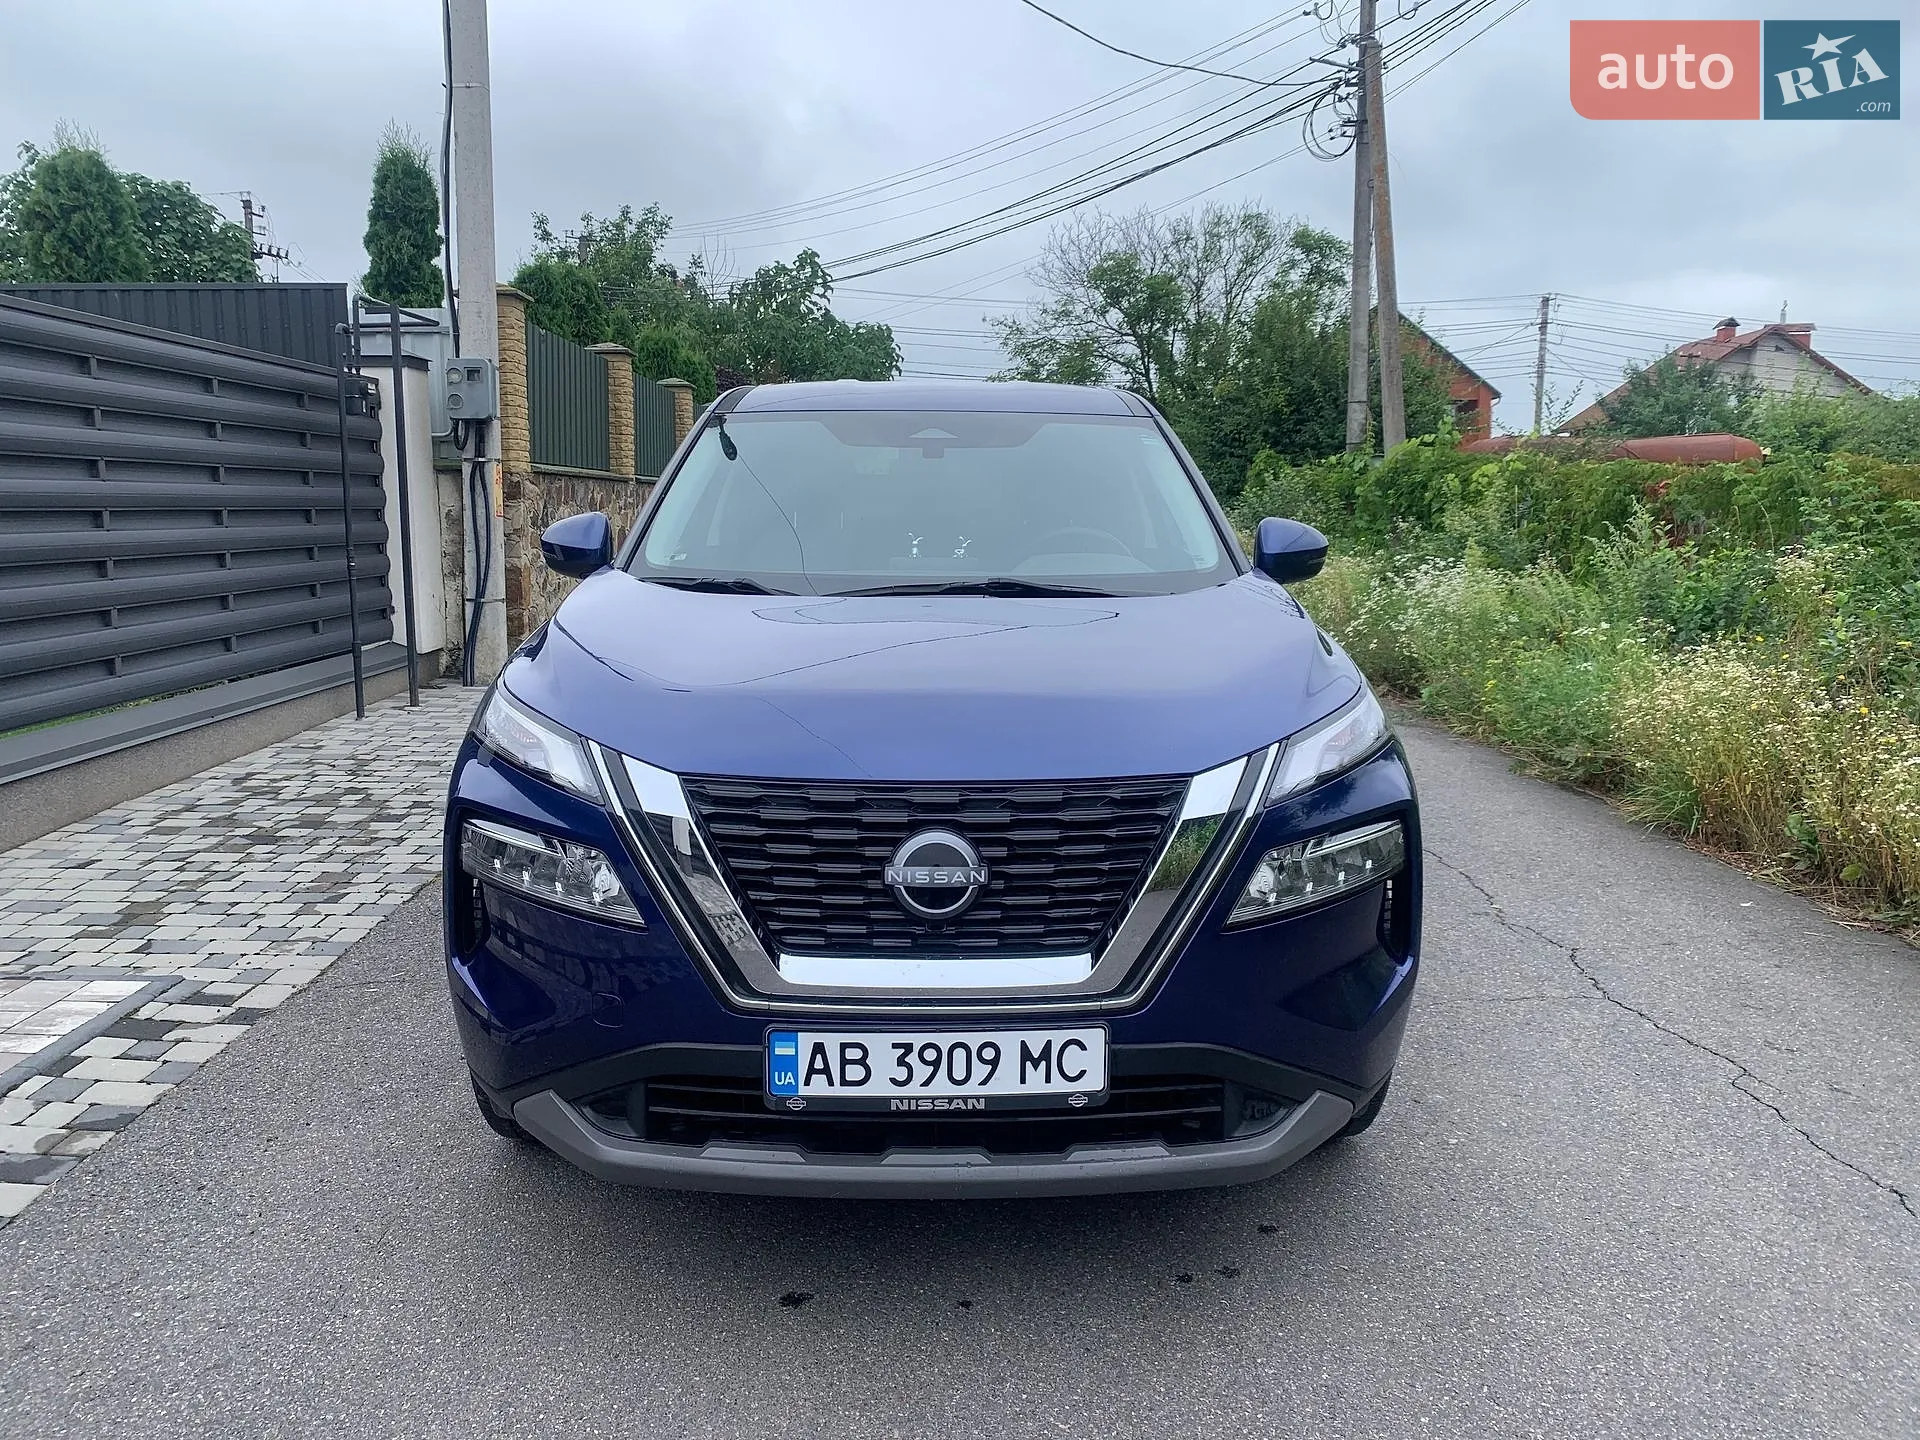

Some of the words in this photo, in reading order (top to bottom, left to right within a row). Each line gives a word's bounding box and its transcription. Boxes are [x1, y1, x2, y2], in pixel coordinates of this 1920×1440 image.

[887, 870, 985, 883] NISSAN
[803, 1041, 872, 1087] AB
[888, 1041, 1002, 1088] 3909
[1019, 1038, 1088, 1085] MC
[774, 1071, 796, 1086] UA
[890, 1098, 985, 1111] NISSAN
